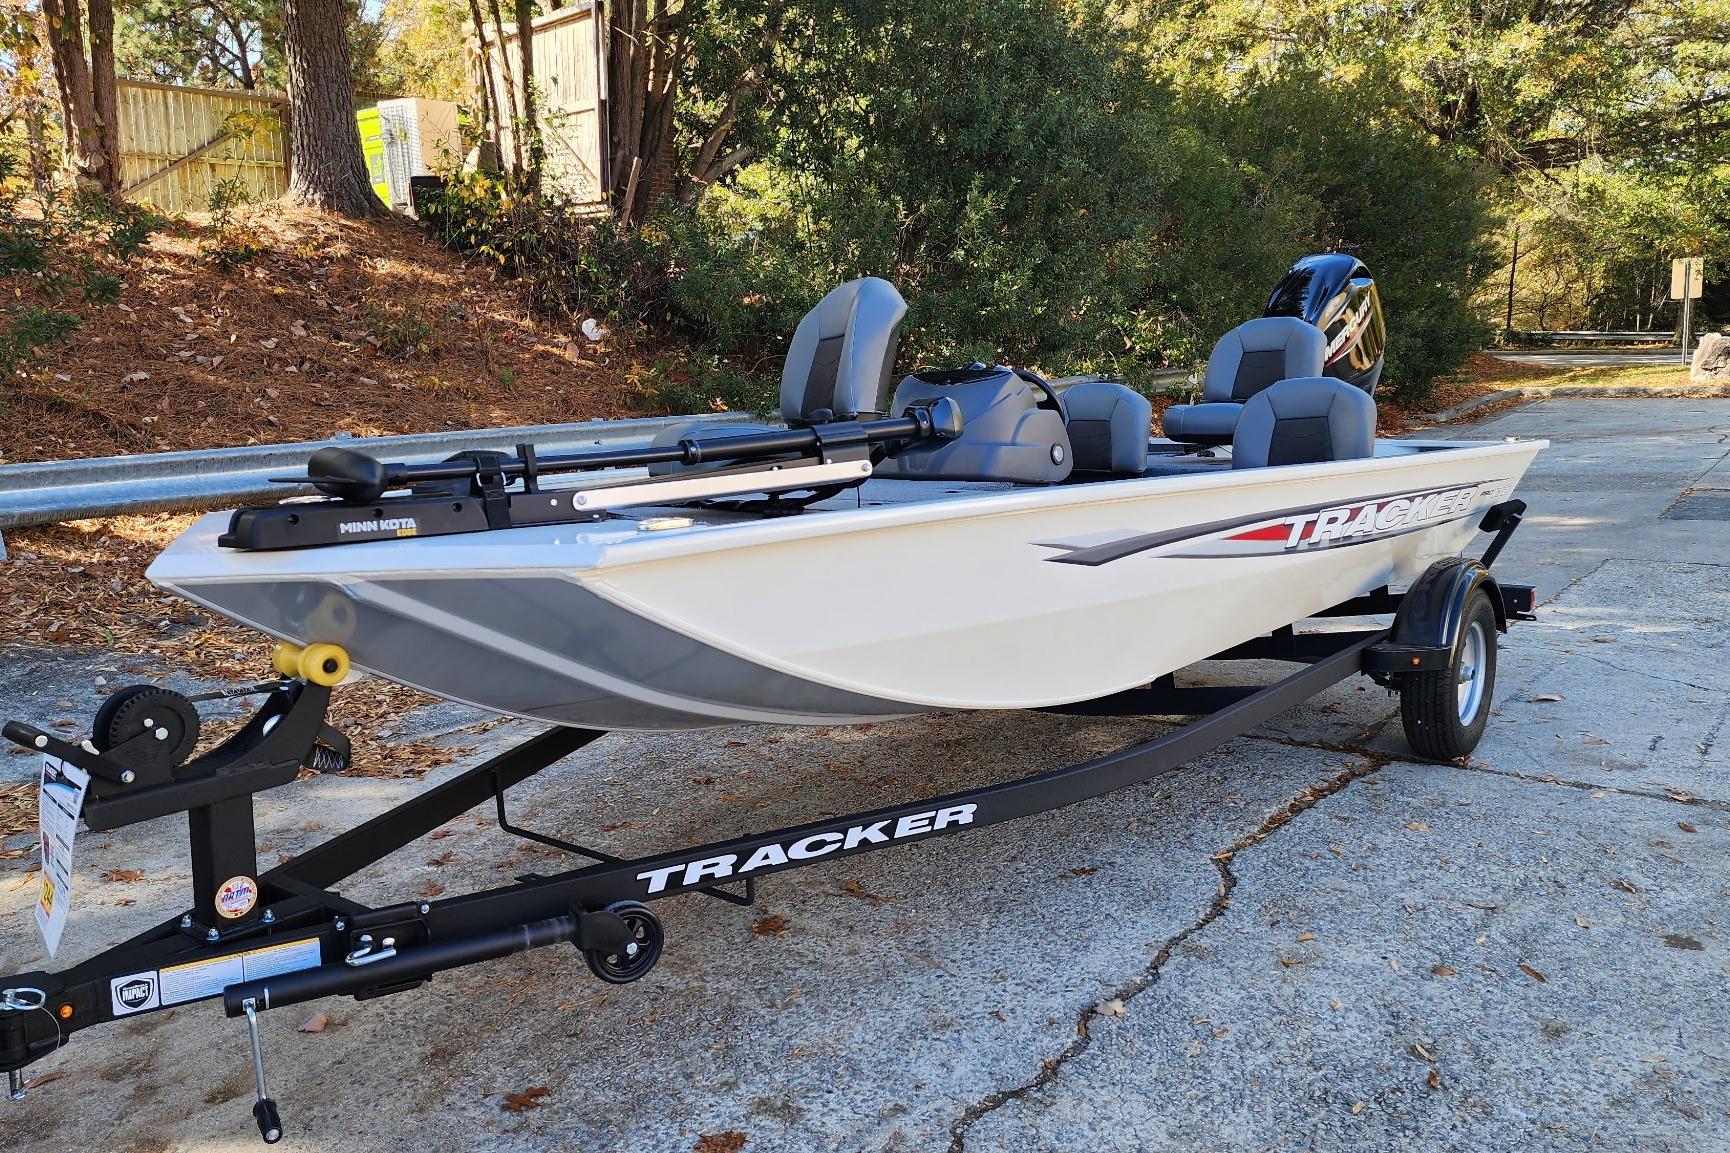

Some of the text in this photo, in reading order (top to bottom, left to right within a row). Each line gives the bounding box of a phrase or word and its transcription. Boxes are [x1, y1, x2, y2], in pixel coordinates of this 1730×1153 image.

[1324, 290, 1371, 361] MERCURY
[340, 517, 417, 534] MINN KOTA
[1284, 485, 1479, 549] TRACKER
[636, 803, 978, 894] TRACKER
[122, 985, 149, 1002] IMPACT
